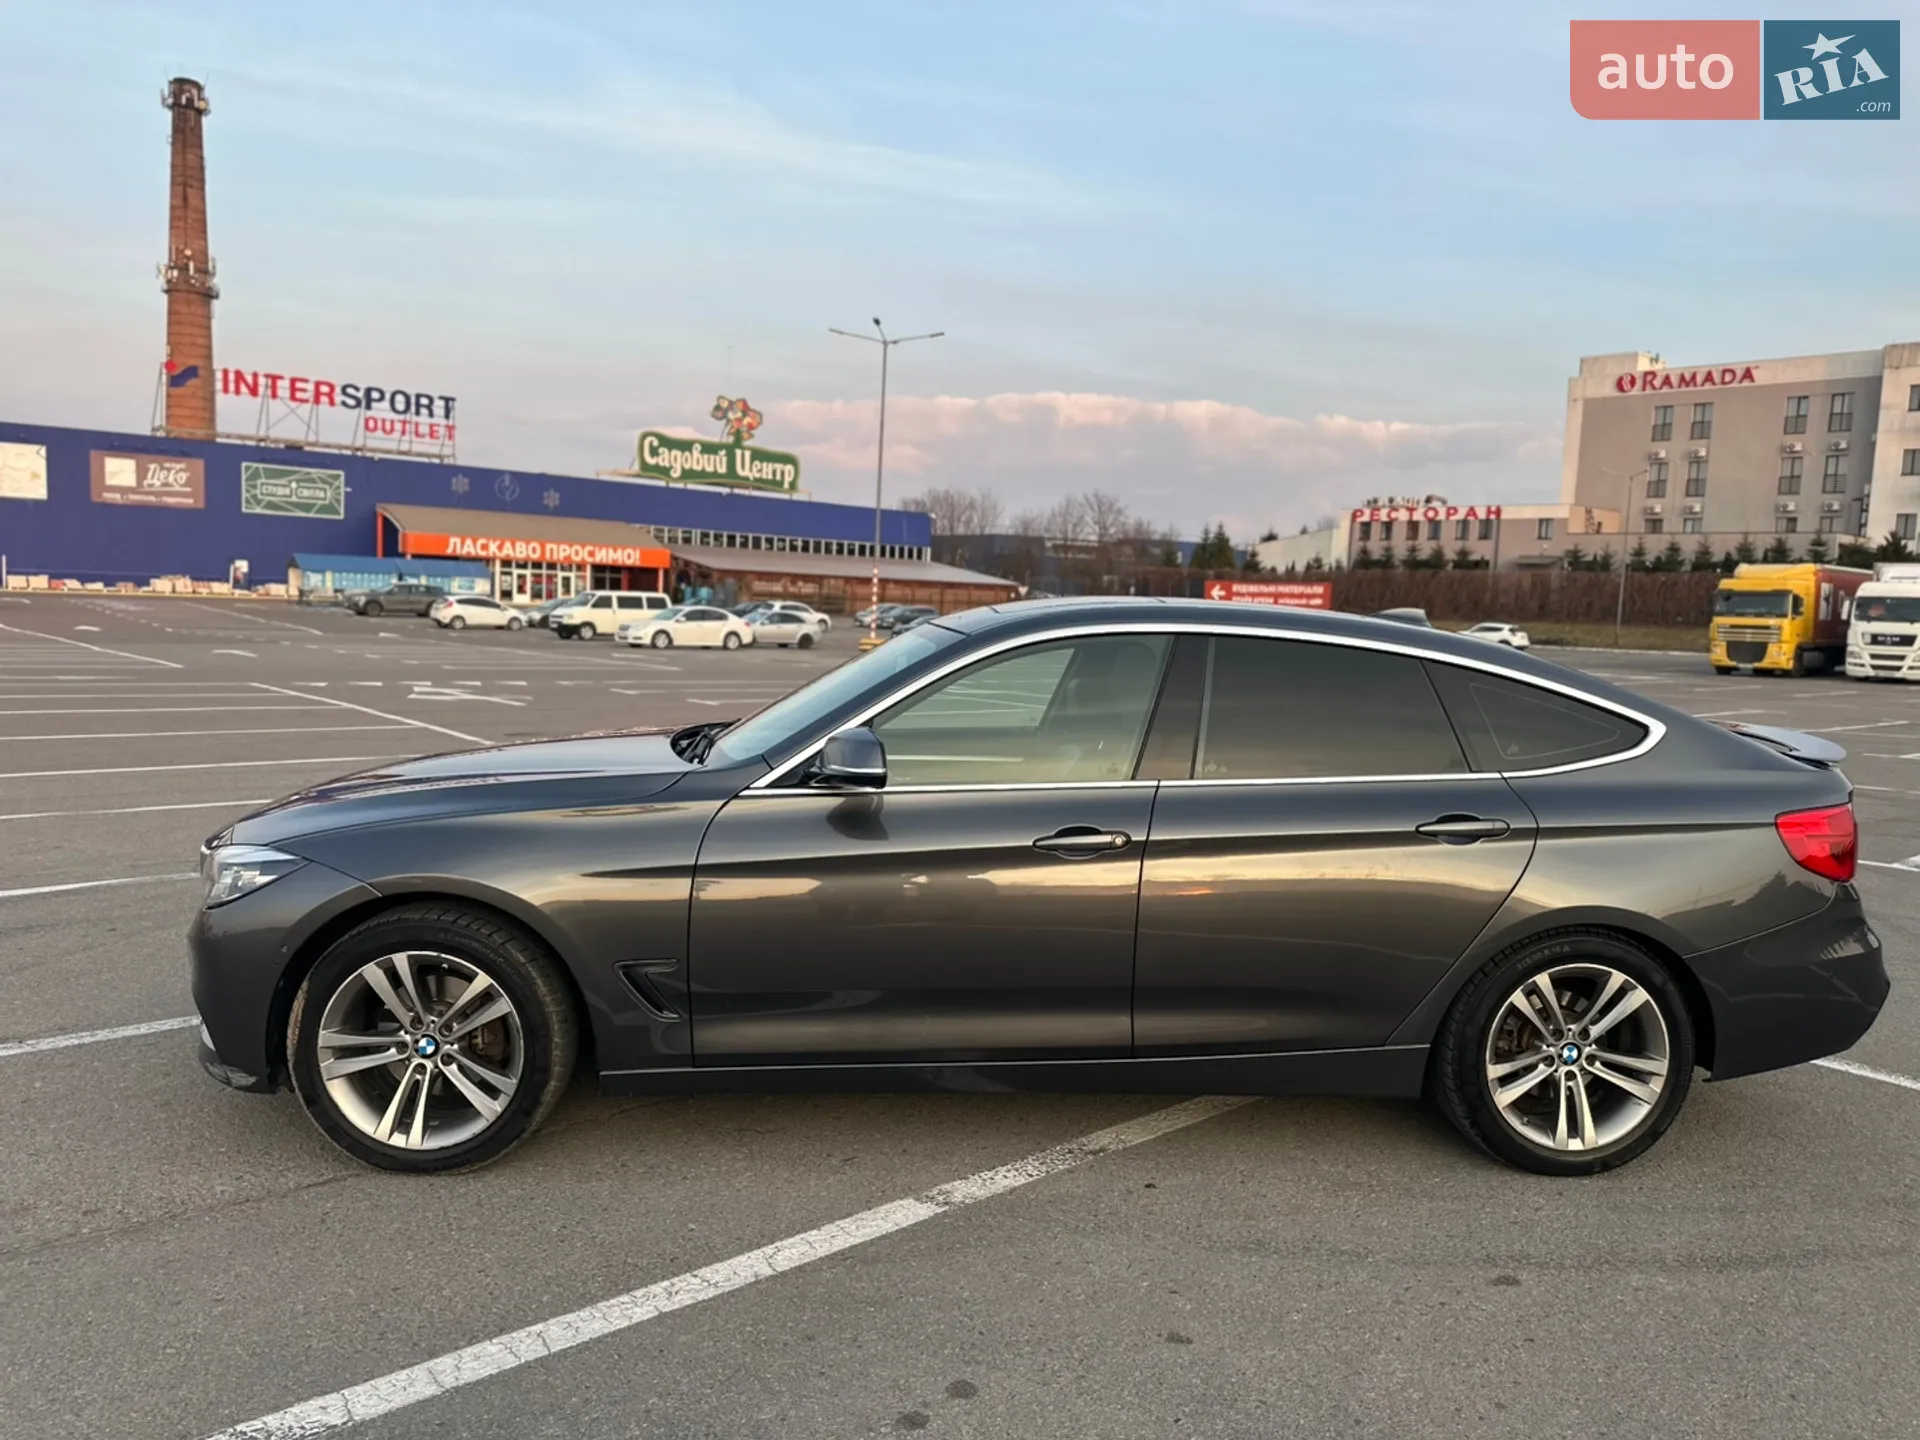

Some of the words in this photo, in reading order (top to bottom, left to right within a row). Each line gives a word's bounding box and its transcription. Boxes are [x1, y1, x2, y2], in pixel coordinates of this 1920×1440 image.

[1641, 366, 1756, 392] RAMADA
[222, 367, 456, 420] INTERSPORT
[364, 416, 456, 441] OUTLET
[643, 435, 728, 478] Садовий
[735, 448, 795, 489] Центр
[1351, 505, 1503, 523] РЕСТОРАН
[445, 536, 542, 559] ЛАСКАВО
[545, 543, 641, 565] ПРОСИМО!
